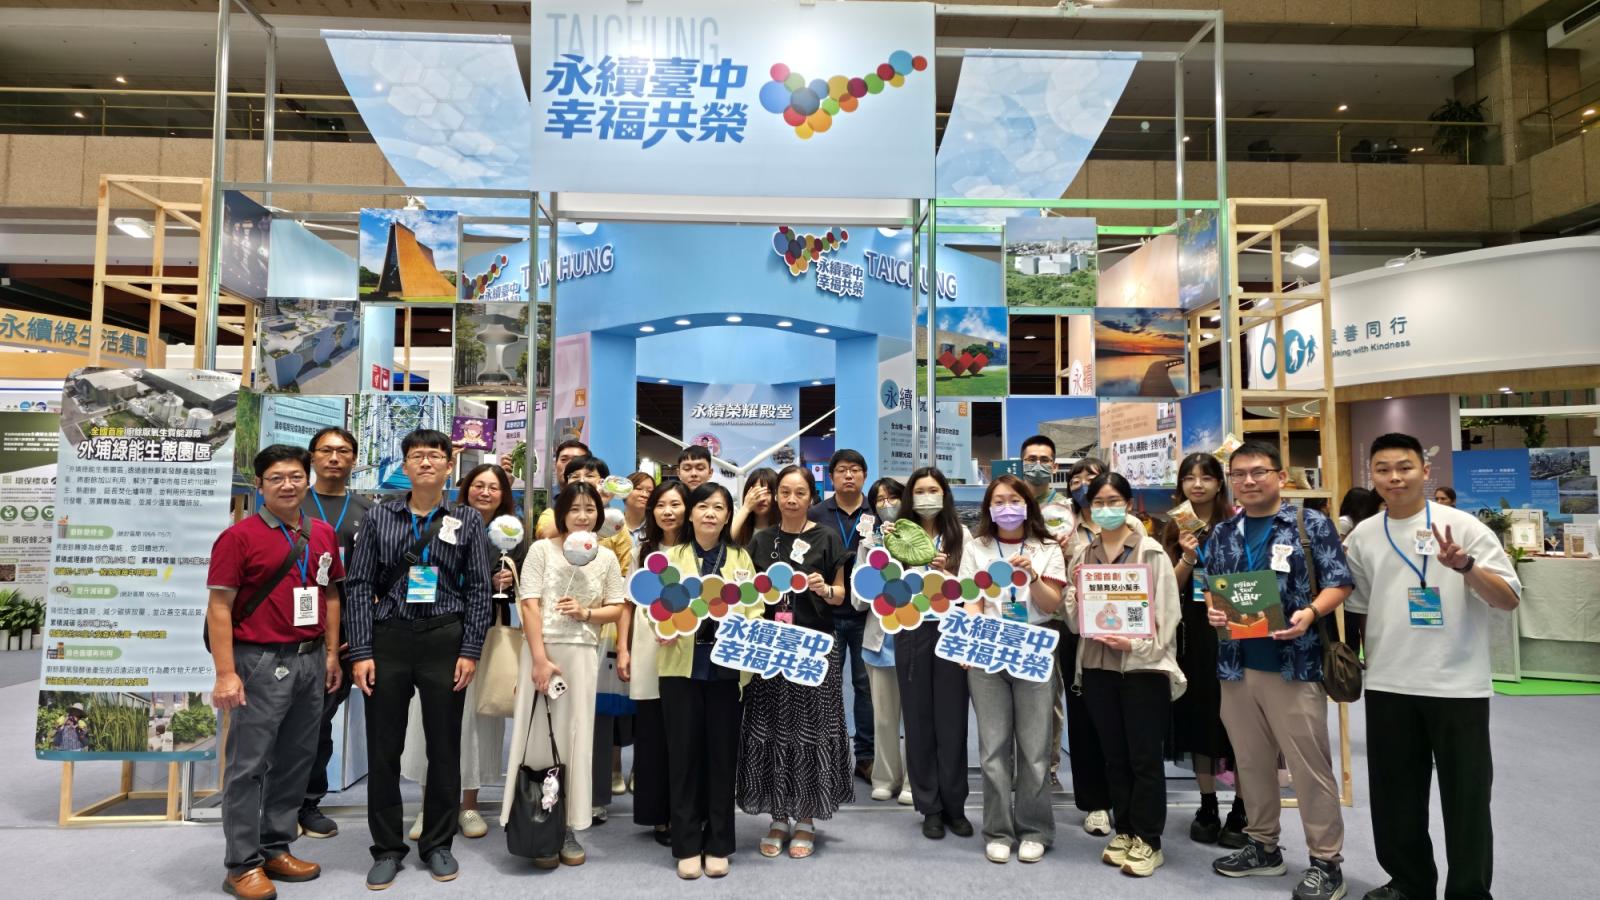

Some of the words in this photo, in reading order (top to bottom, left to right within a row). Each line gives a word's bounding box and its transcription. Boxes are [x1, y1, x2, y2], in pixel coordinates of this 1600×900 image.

[546, 13, 719, 62] TAICHUNG
[543, 53, 749, 100] 永續臺中
[544, 98, 749, 149] 幸福共榮
[818, 258, 863, 280] 永續臺中
[818, 275, 864, 296] 幸福共榮
[1354, 344, 1369, 354] with
[1371, 339, 1410, 351] Kindness
[691, 402, 793, 419] 永續榮耀殿堂
[78, 439, 212, 461] 外埔綠能生態園區
[1085, 572, 1121, 581] 全國首創
[720, 614, 830, 657] 永續臺中
[943, 610, 1055, 653] 永續臺中
[715, 640, 825, 683] 幸福共榮
[939, 635, 1051, 679] 幸福共榮
